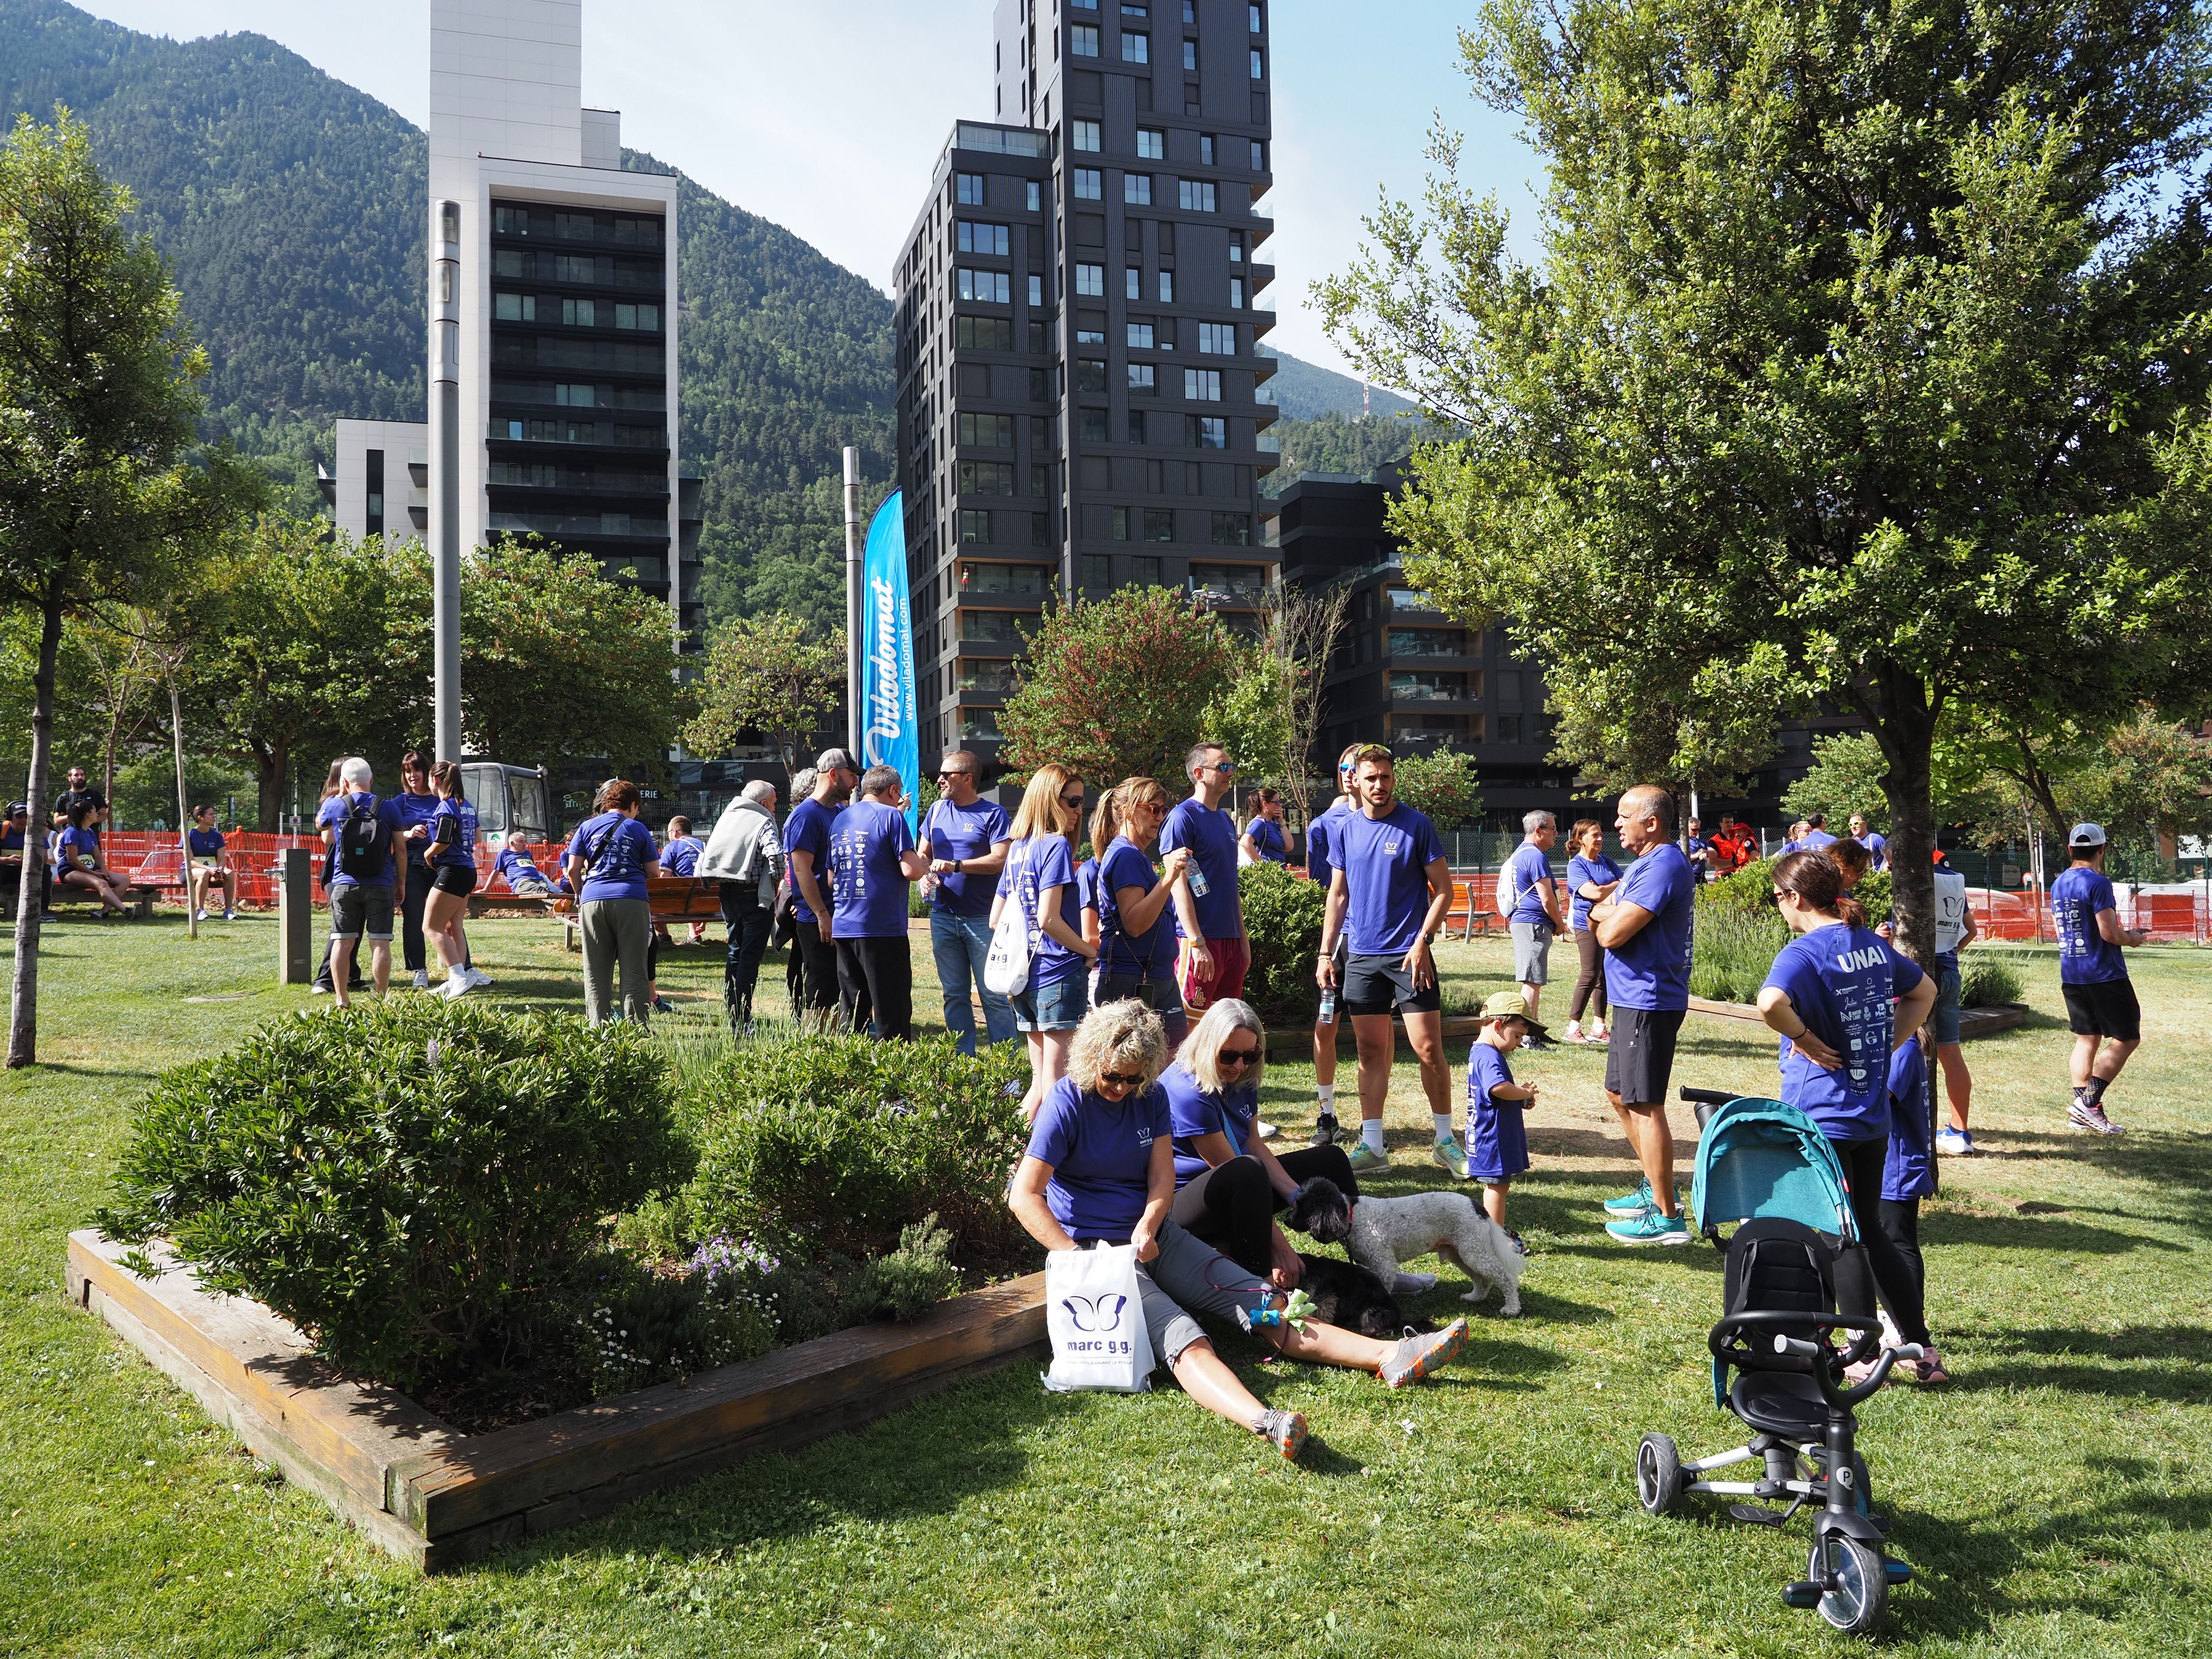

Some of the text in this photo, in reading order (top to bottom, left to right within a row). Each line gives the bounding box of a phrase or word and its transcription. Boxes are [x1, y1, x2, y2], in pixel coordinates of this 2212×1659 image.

[866, 576, 900, 766] Viladomat
[899, 598, 913, 721] www.viladomat.com
[1837, 945, 1888, 973] UNAI
[1193, 986, 1206, 1007] LA
[1067, 1341, 1132, 1354] marc g.g.
